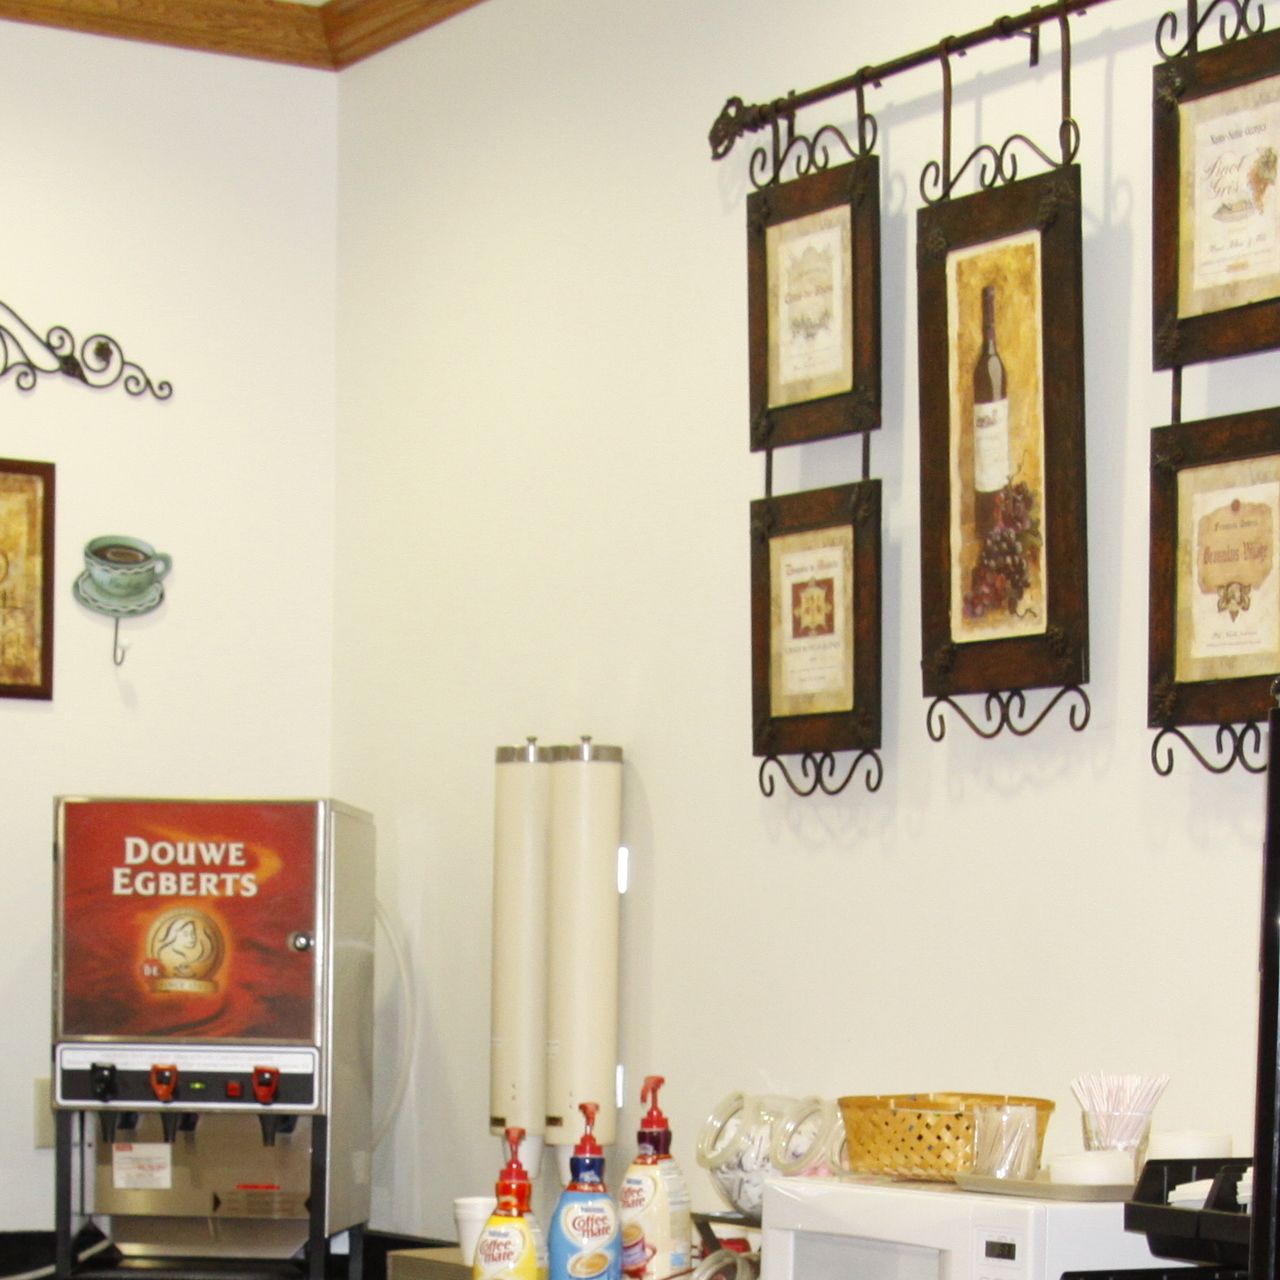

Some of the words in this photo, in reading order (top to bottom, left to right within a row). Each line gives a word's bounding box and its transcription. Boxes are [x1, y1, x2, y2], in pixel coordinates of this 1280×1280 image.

[124, 836, 246, 867] DOUWE
[112, 866, 258, 898] EGBERTS
[572, 1214, 609, 1232] Coffee
[582, 1226, 611, 1239] mate
[479, 1239, 512, 1256] Coffee
